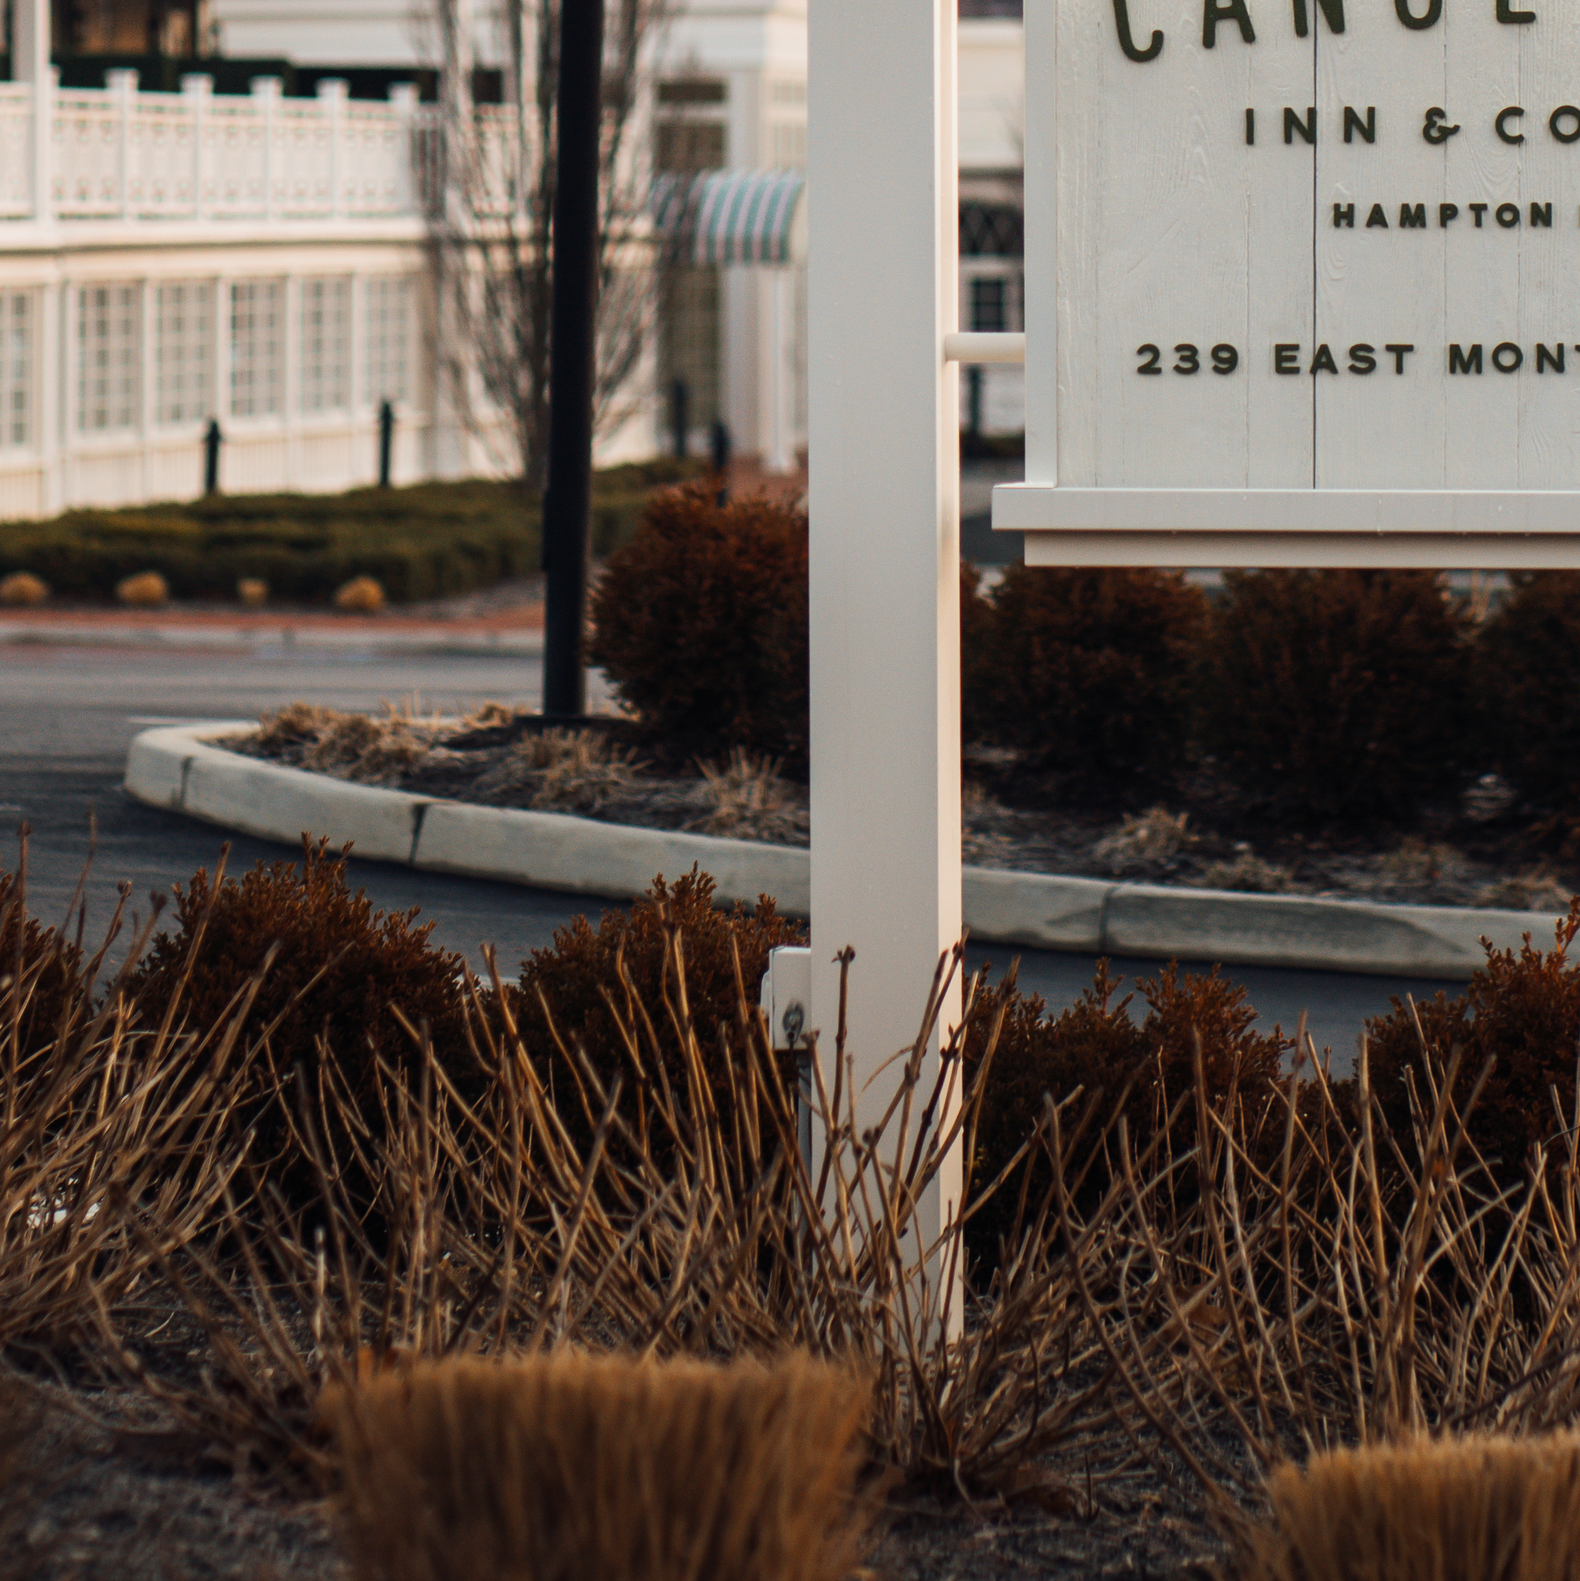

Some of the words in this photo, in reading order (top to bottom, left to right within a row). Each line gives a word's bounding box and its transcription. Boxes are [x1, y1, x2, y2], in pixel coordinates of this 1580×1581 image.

[1245, 106, 1376, 145] INN
[1422, 107, 1461, 145] &
[1332, 202, 1553, 229] HAMPTON
[1136, 343, 1239, 376] 239
[1274, 343, 1415, 376] EAST
